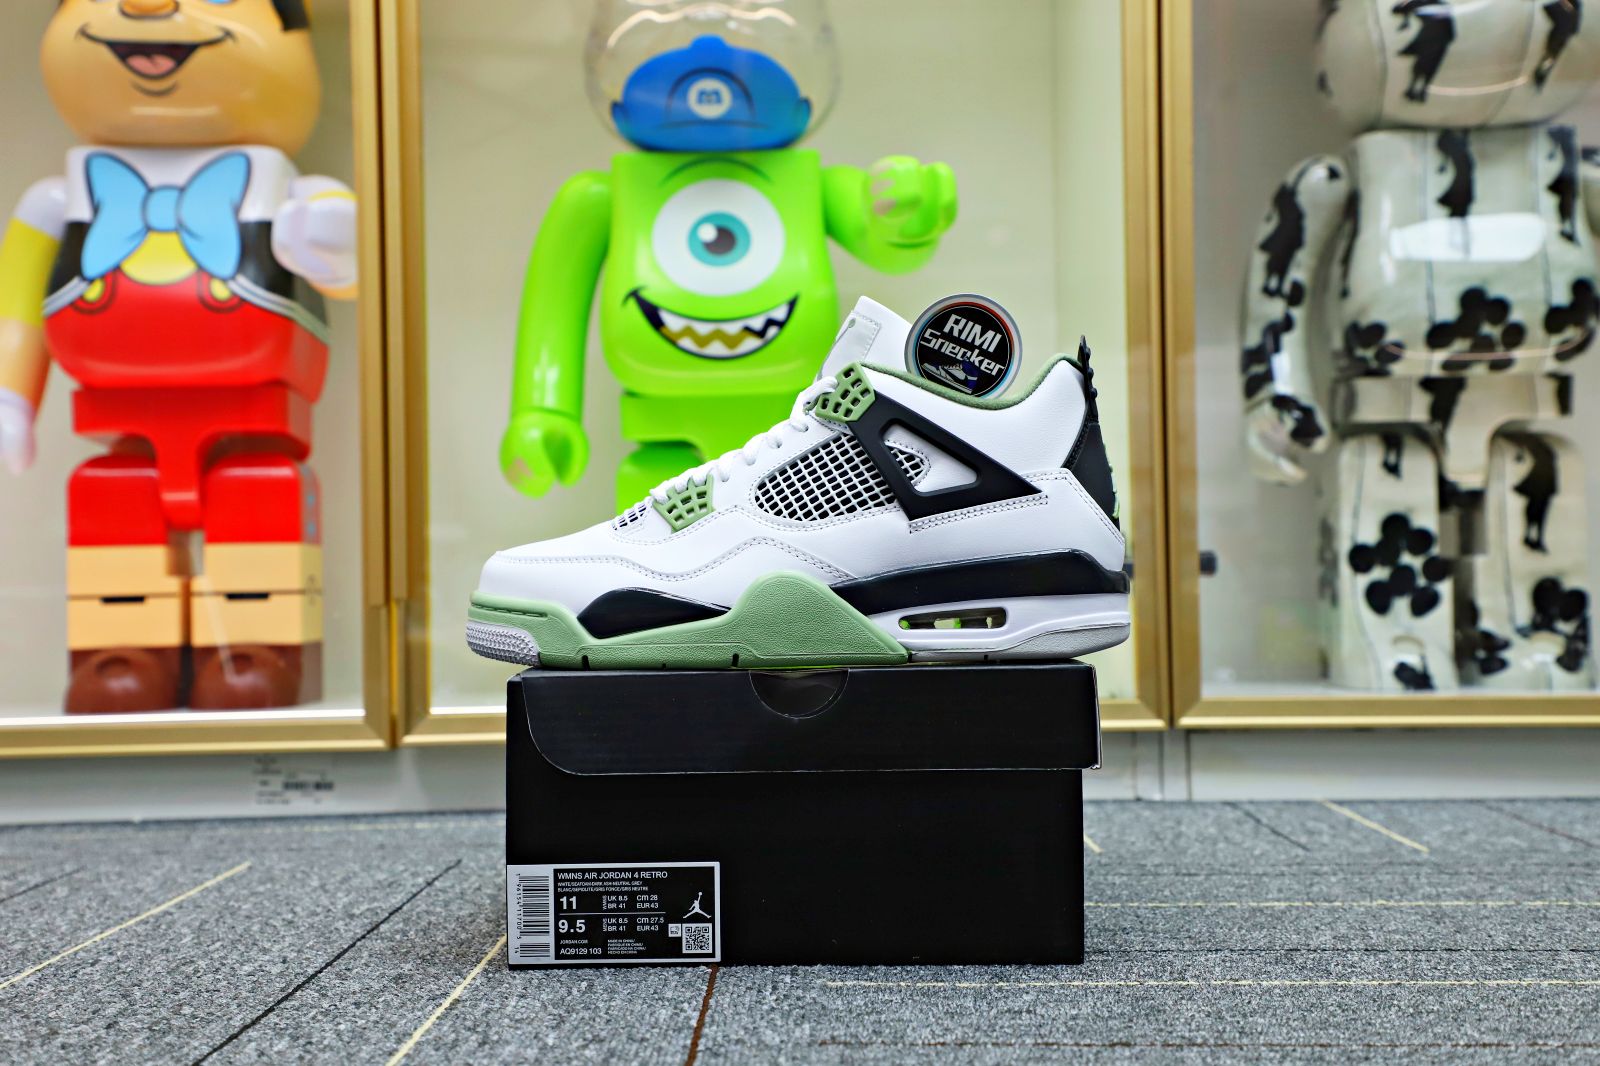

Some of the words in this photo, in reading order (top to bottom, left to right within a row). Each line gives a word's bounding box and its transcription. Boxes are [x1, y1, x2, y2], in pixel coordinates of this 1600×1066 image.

[943, 313, 1002, 353] RIMI
[920, 328, 1006, 376] Sneaker
[560, 896, 576, 910] 11
[558, 920, 586, 933] 9.5
